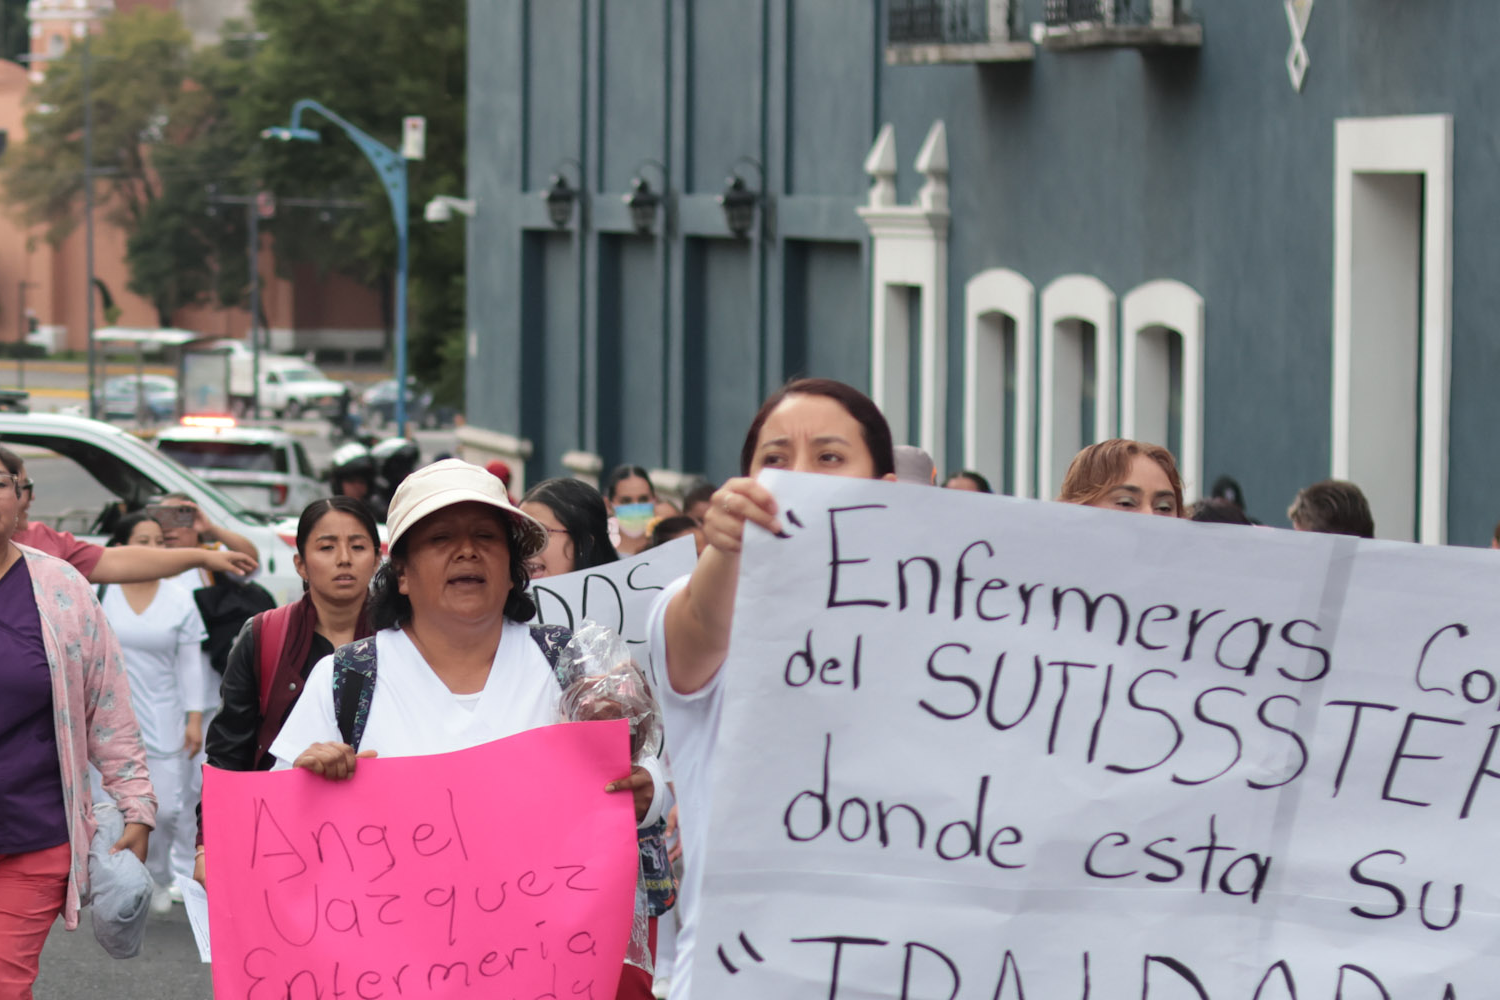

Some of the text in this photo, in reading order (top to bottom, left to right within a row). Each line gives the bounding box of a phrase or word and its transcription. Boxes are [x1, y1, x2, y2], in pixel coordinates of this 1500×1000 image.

[784, 629, 862, 690] del
[1415, 622, 1500, 711] Co
[251, 788, 469, 884] Angel
[784, 732, 1026, 868] donde
[1084, 813, 1272, 904] esta
